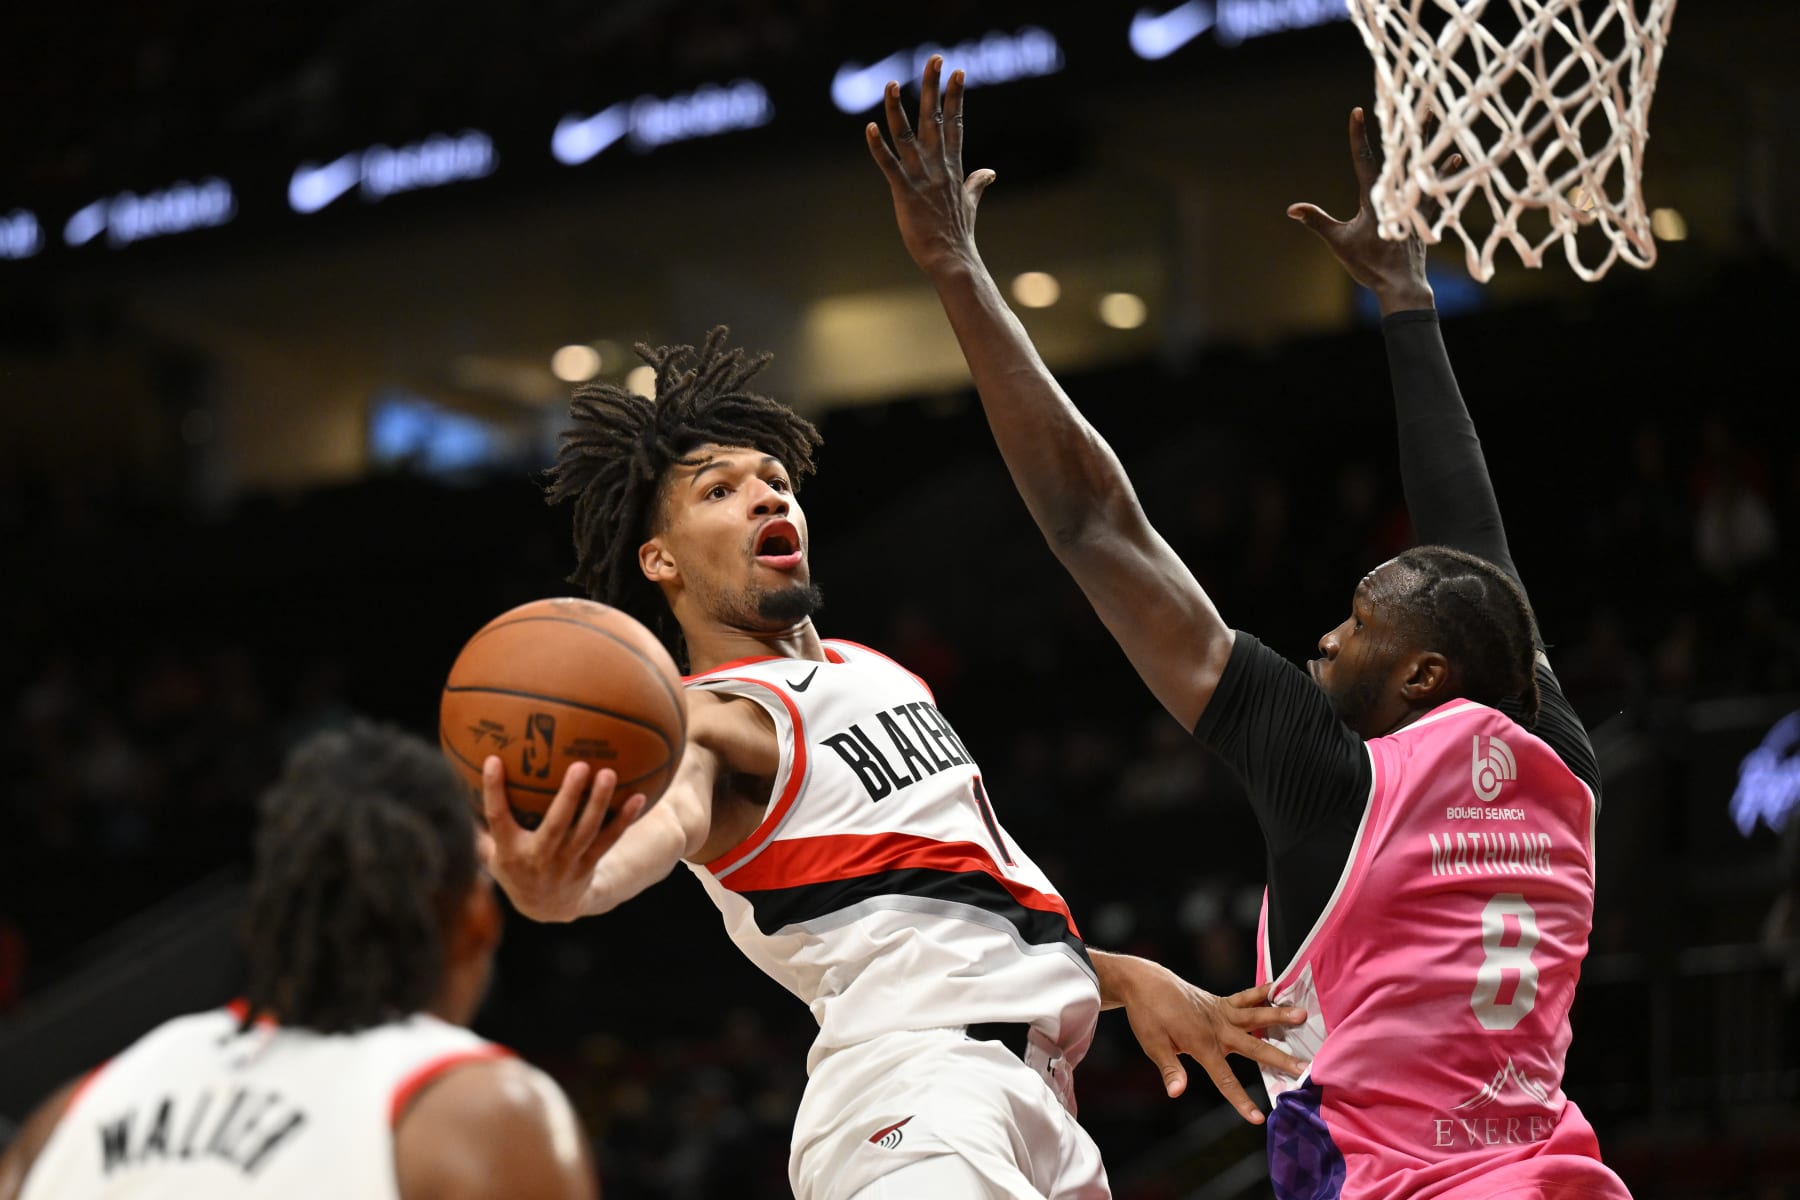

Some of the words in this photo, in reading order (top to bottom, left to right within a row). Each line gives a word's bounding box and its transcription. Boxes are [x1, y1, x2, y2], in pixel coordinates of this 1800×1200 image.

[1446, 807, 1484, 820] BOWEN
[1485, 808, 1526, 821] SEARCH
[1428, 832, 1554, 877] MATHIANG
[1470, 893, 1541, 1030] 8
